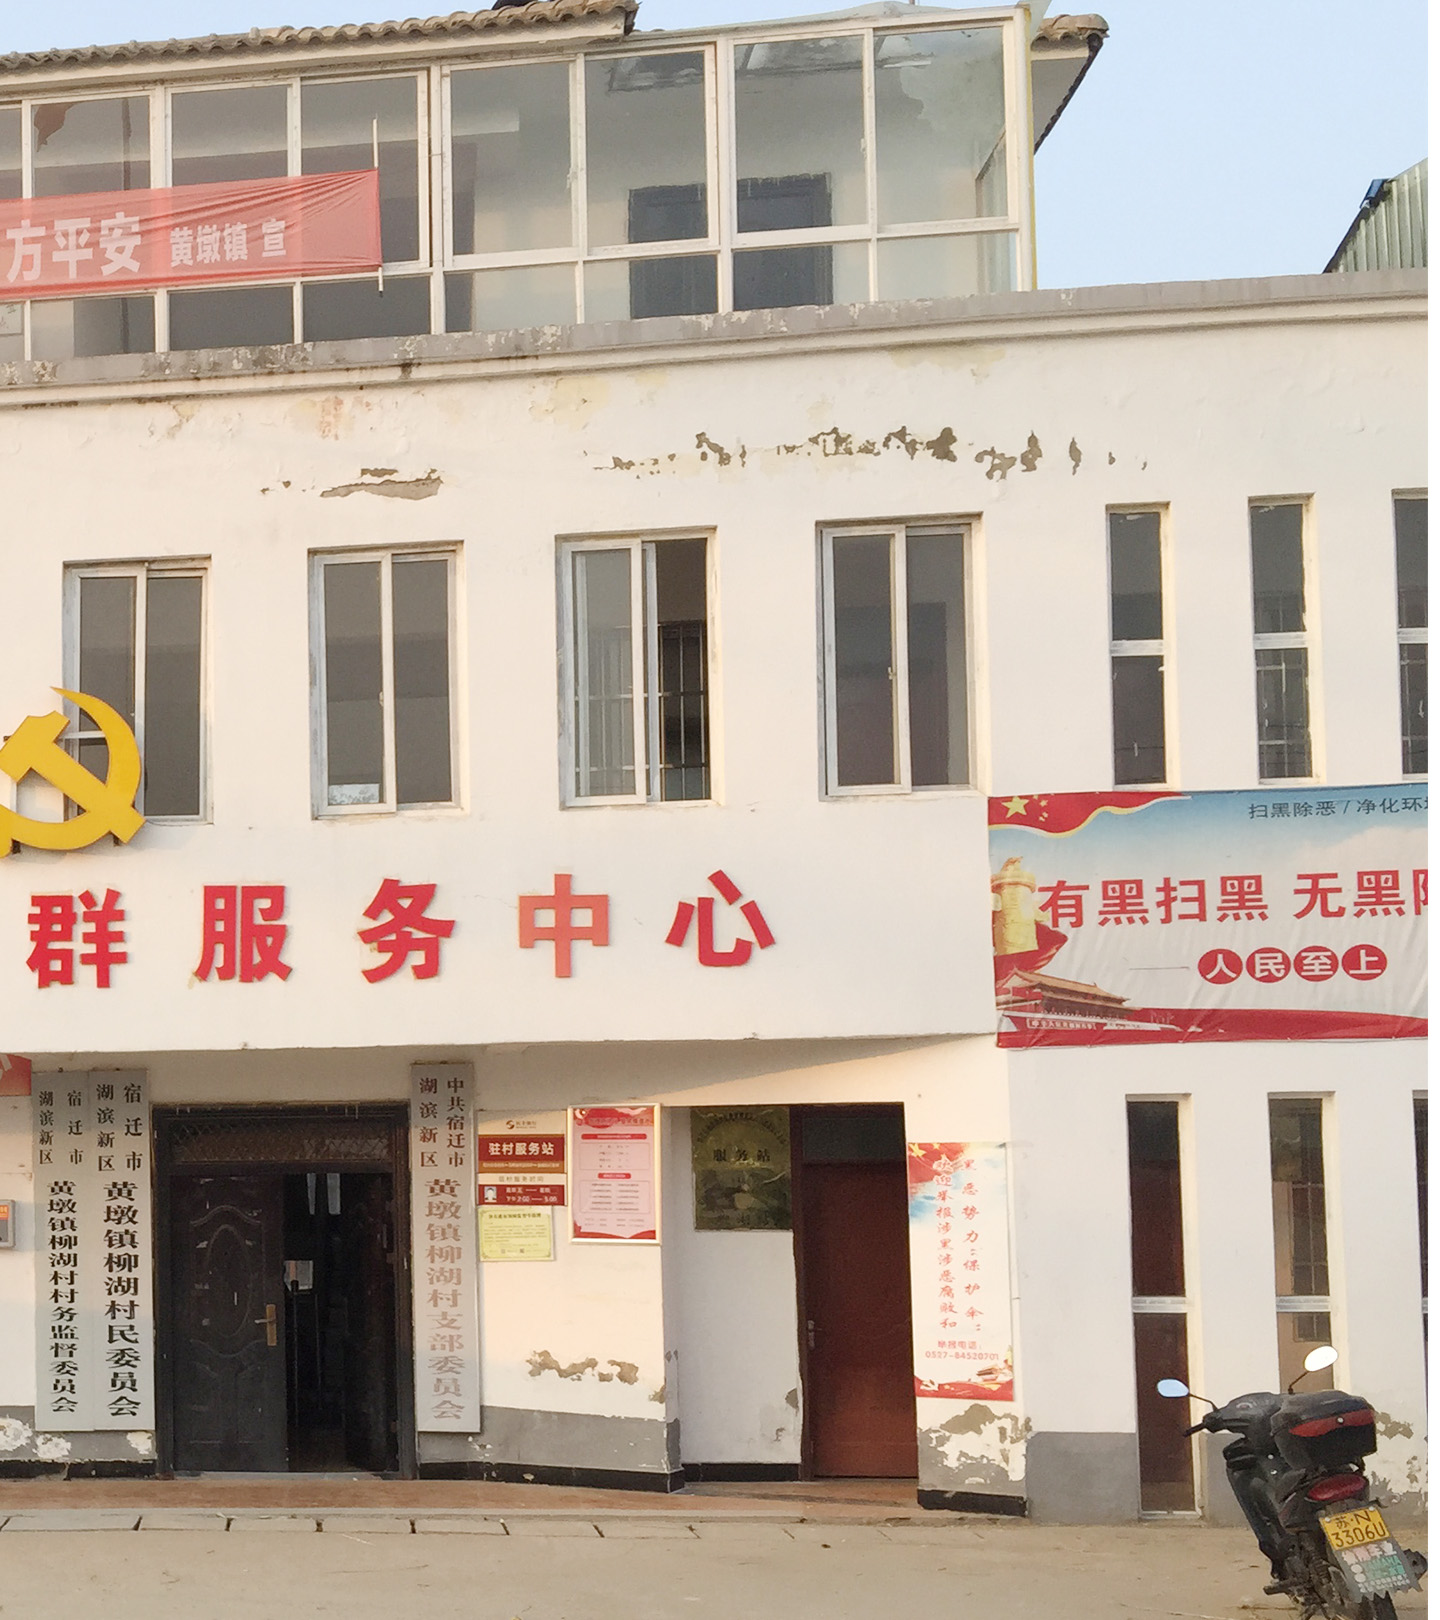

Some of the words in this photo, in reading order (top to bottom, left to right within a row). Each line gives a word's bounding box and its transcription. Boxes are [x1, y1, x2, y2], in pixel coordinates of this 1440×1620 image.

[169, 222, 249, 269] 黄墩镇
[261, 217, 287, 259] 宣
[1248, 796, 1428, 820] 扫黑除恶/净化环
[1037, 874, 1269, 929] 有黑扫黑
[1202, 946, 1386, 982] 人民至上
[39, 1090, 54, 1165] 湖滨新区
[67, 1090, 84, 1165] 宿迁市
[96, 1084, 116, 1173] 湖滨新区
[123, 1083, 143, 1172] 宿迁市
[419, 1077, 439, 1168] 湖滨新区
[446, 1077, 466, 1168] 中共宿迁市
[488, 1142, 555, 1156] 驻村服务站
[46, 1180, 79, 1414] 黄墩镇柳湖村村务监督委员会
[102, 1181, 142, 1418] 黄墩镇柳湖村民委员会
[425, 1178, 466, 1420] 黄墩镇柳湖村支部委员会
[1331, 1521, 1386, 1548] 3306U
